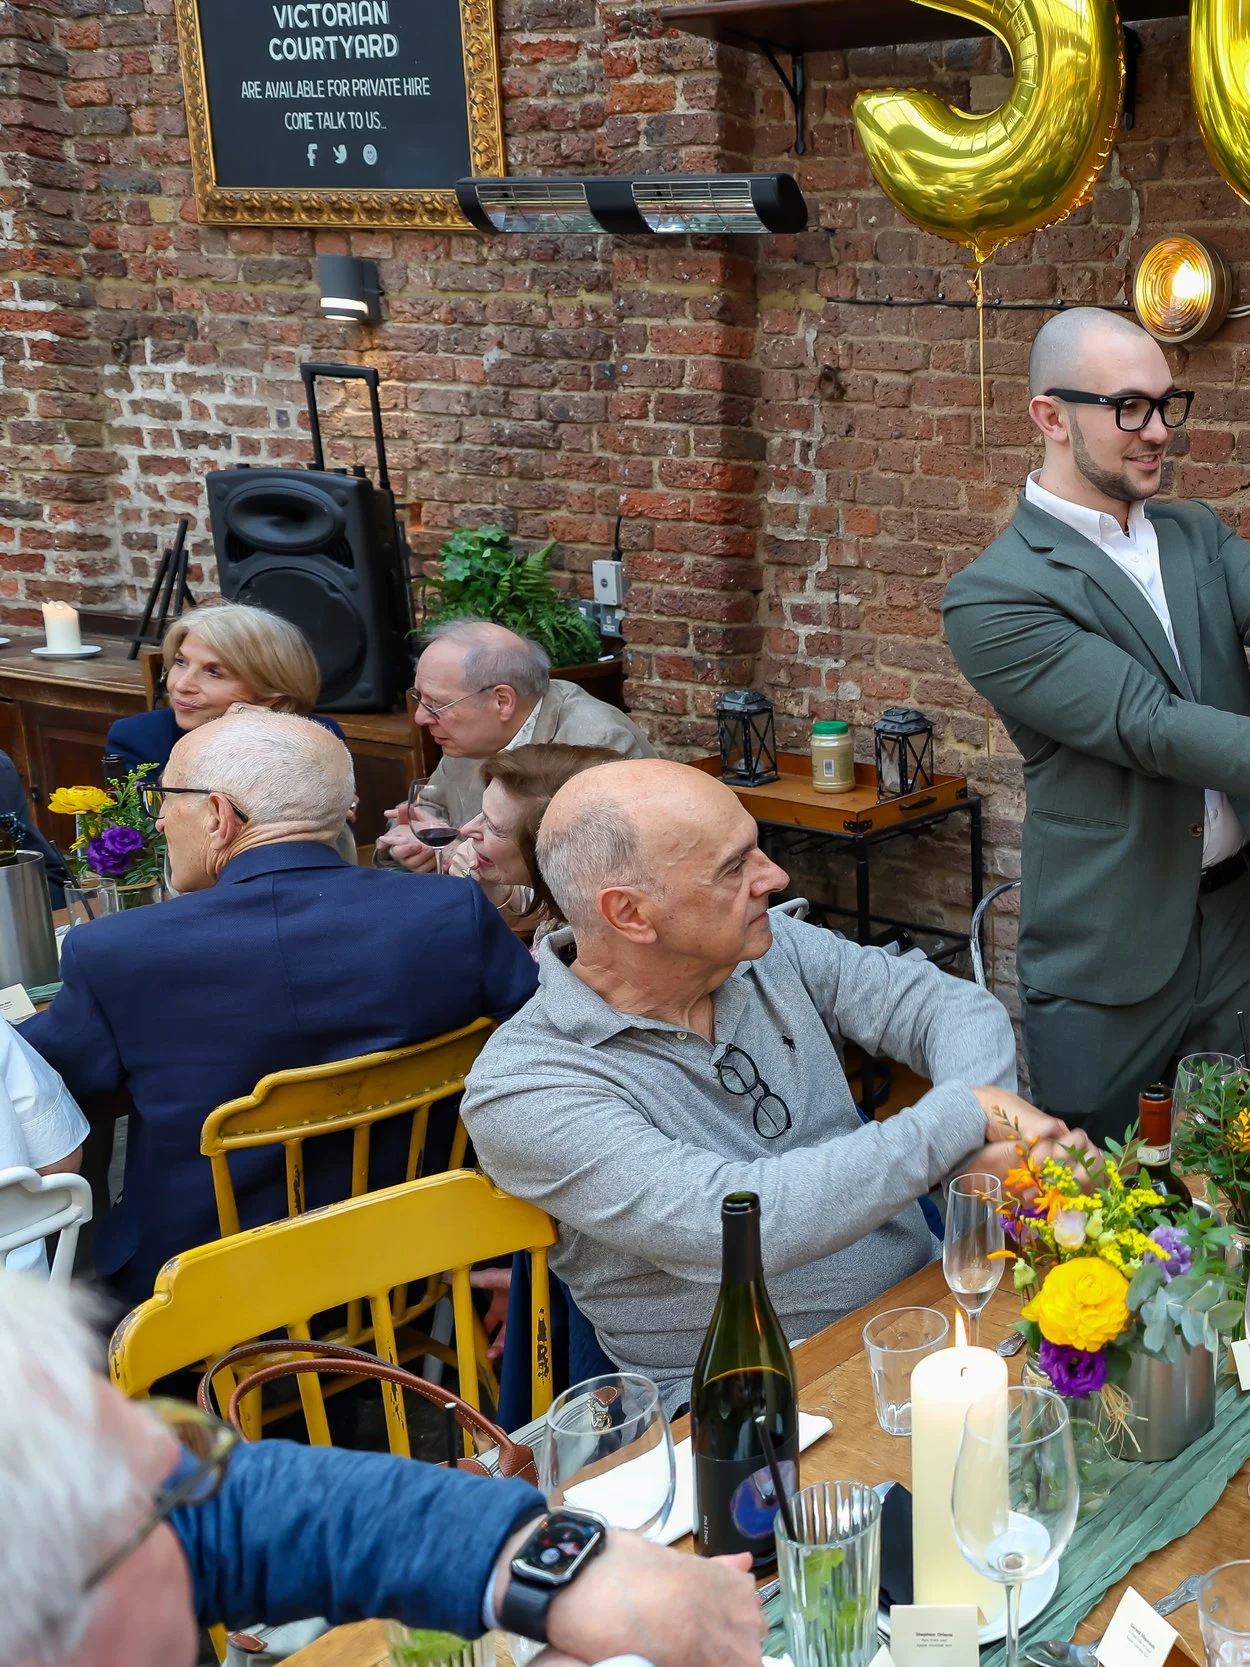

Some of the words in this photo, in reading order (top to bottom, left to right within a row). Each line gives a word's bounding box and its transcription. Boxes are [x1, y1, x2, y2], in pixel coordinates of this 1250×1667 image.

[272, 0, 390, 29] VICTORIAN
[268, 33, 400, 61] COURTYARD
[241, 80, 263, 99] ARE
[265, 79, 326, 98] AVAILABLE
[327, 78, 350, 97] FOR
[352, 77, 402, 97] PRIVATE
[403, 76, 432, 96] HIRE
[284, 111, 315, 130] COME
[315, 111, 347, 130] TALK
[347, 111, 364, 130] TO
